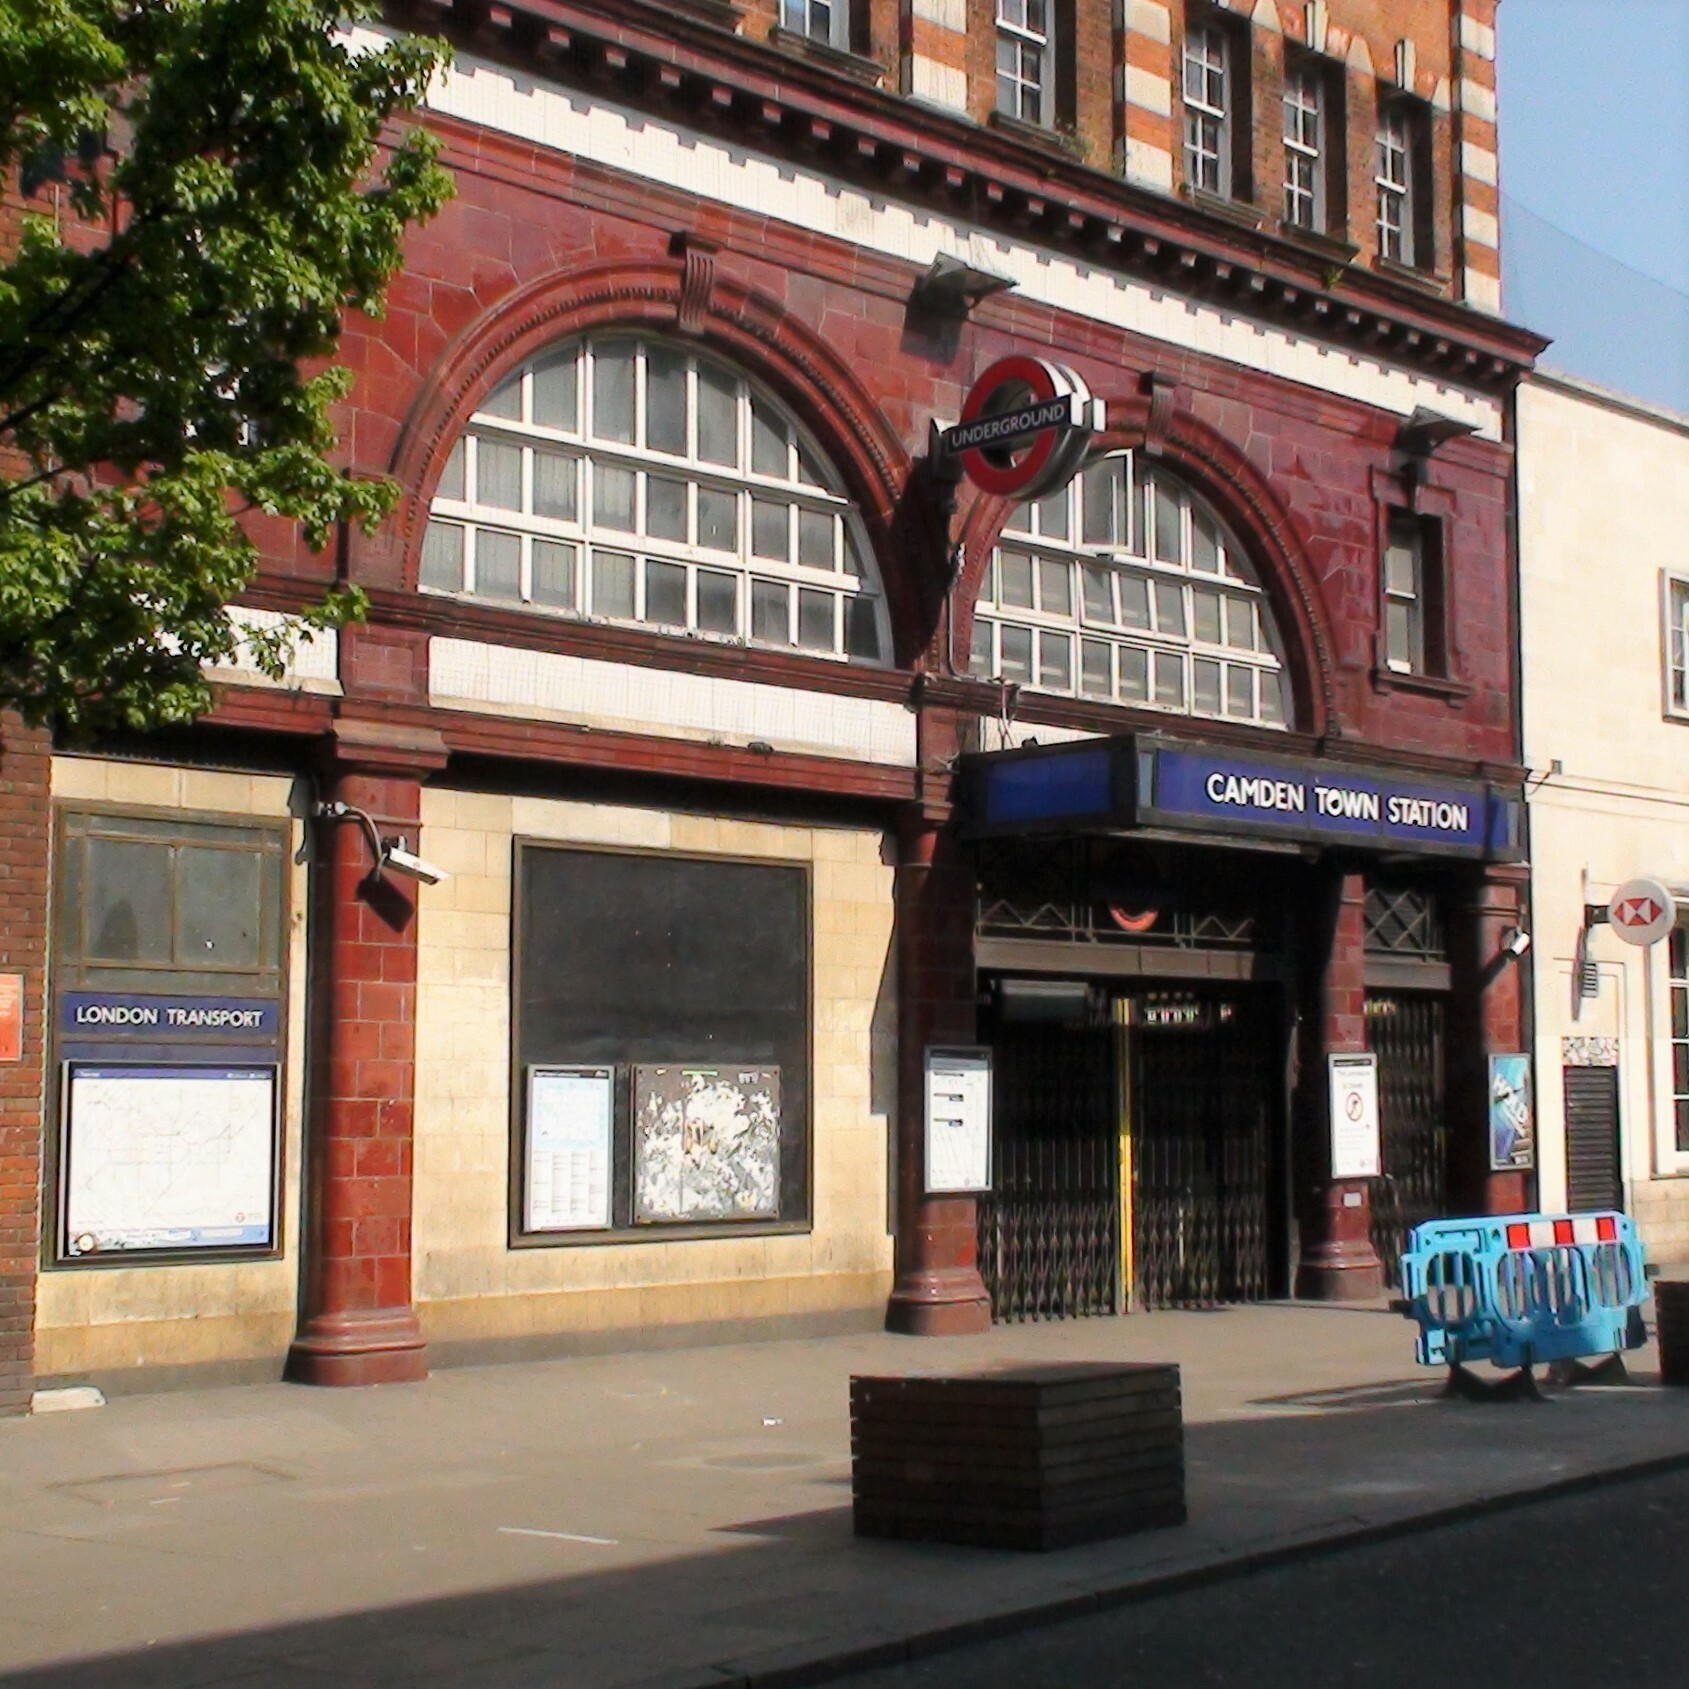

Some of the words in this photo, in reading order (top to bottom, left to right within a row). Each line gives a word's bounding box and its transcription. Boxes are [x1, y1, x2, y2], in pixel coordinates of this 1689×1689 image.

[952, 405, 1065, 446] UNDERGROUND
[1206, 774, 1305, 811] CAMDEN
[1314, 787, 1379, 820] TOWN
[1387, 797, 1468, 830] STATION
[76, 1006, 158, 1025] LONDON
[167, 1009, 263, 1028] TRANSPORT
